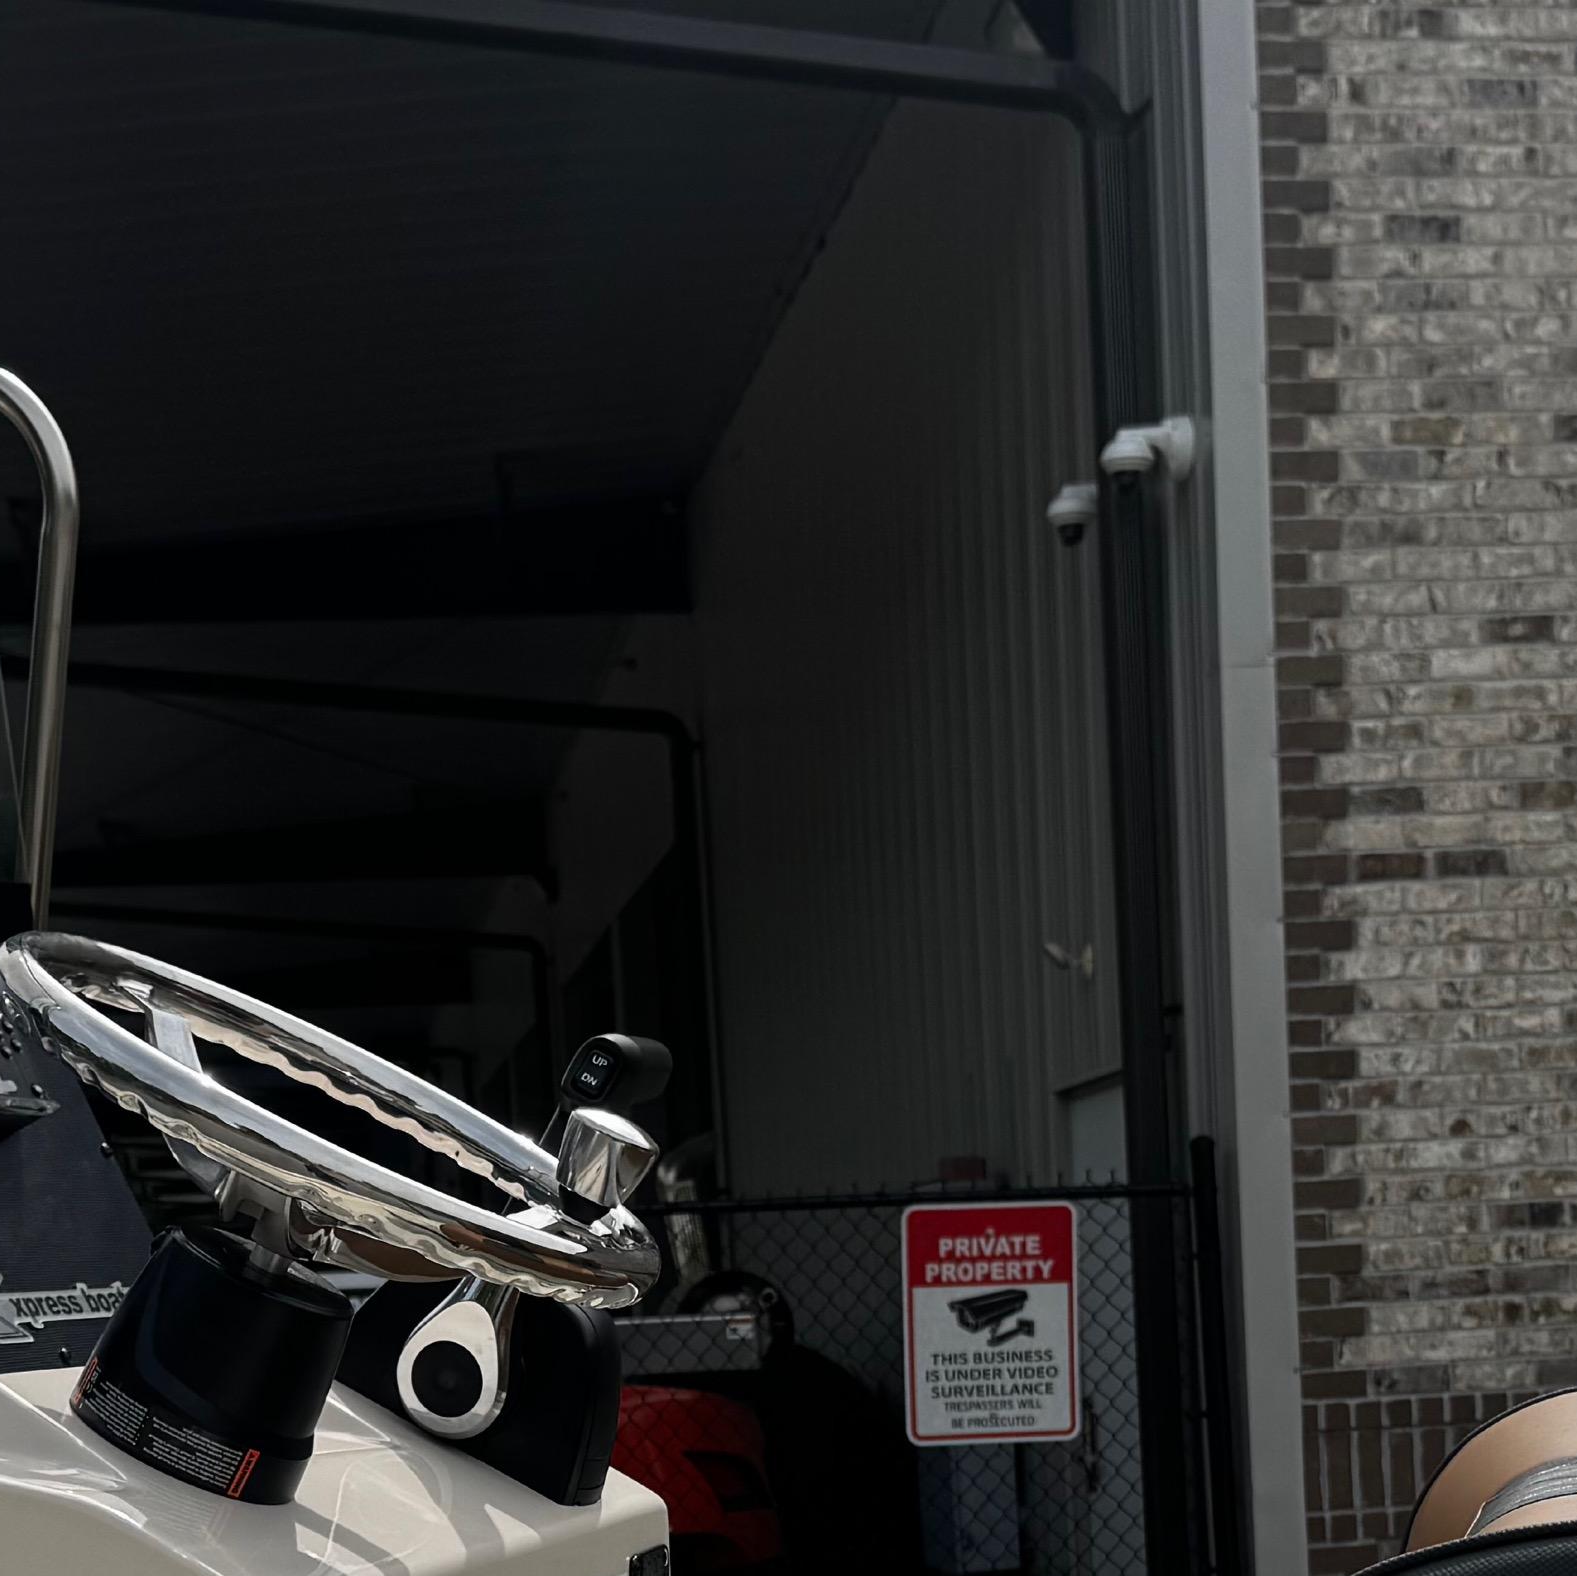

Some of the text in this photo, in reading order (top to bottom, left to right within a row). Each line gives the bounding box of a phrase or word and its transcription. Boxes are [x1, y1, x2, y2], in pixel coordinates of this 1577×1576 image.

[592, 1054, 608, 1067] UP
[581, 1072, 598, 1086] DN
[938, 1235, 1041, 1259] PRIVATE
[925, 1259, 1054, 1283] PROPERTY
[9, 1294, 83, 1325] xpress
[80, 1287, 125, 1312] boa
[930, 1349, 1053, 1366] THIS BUSINESS
[925, 1365, 1058, 1383] IS UNDER VIDEO
[931, 1382, 1054, 1399] SURVEILLANCE
[944, 1398, 1042, 1412] TRESPASSERS WILL
[951, 1415, 1035, 1429] BE PROSECUTED
